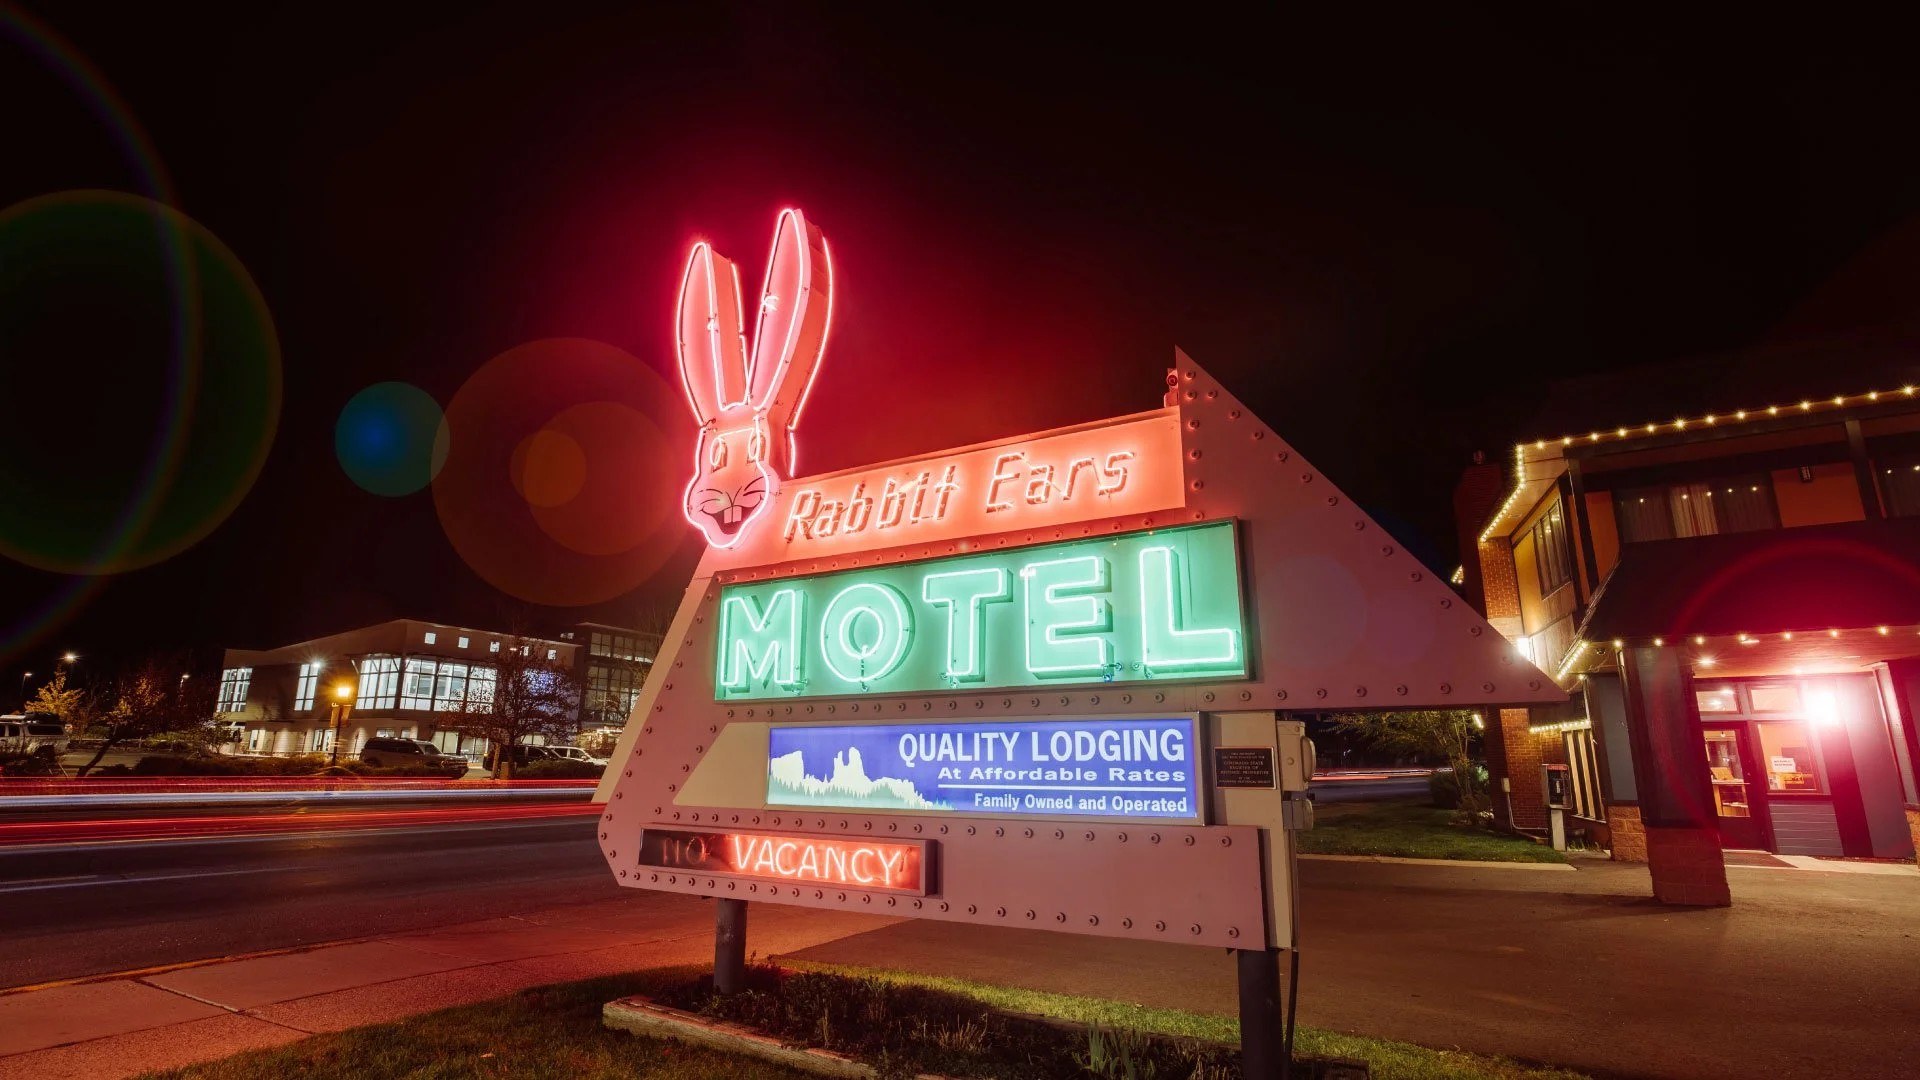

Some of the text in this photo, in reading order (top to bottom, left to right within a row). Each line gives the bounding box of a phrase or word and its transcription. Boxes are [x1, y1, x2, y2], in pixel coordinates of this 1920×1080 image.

[783, 451, 1135, 544] Rabbit Ears
[719, 546, 1241, 693] MOTEL
[899, 729, 1185, 768] QUALITY LODGING
[938, 767, 1186, 782] At Affordable Rates
[974, 793, 1187, 813] Family Owned and Operated
[733, 834, 901, 886] VACANCY
